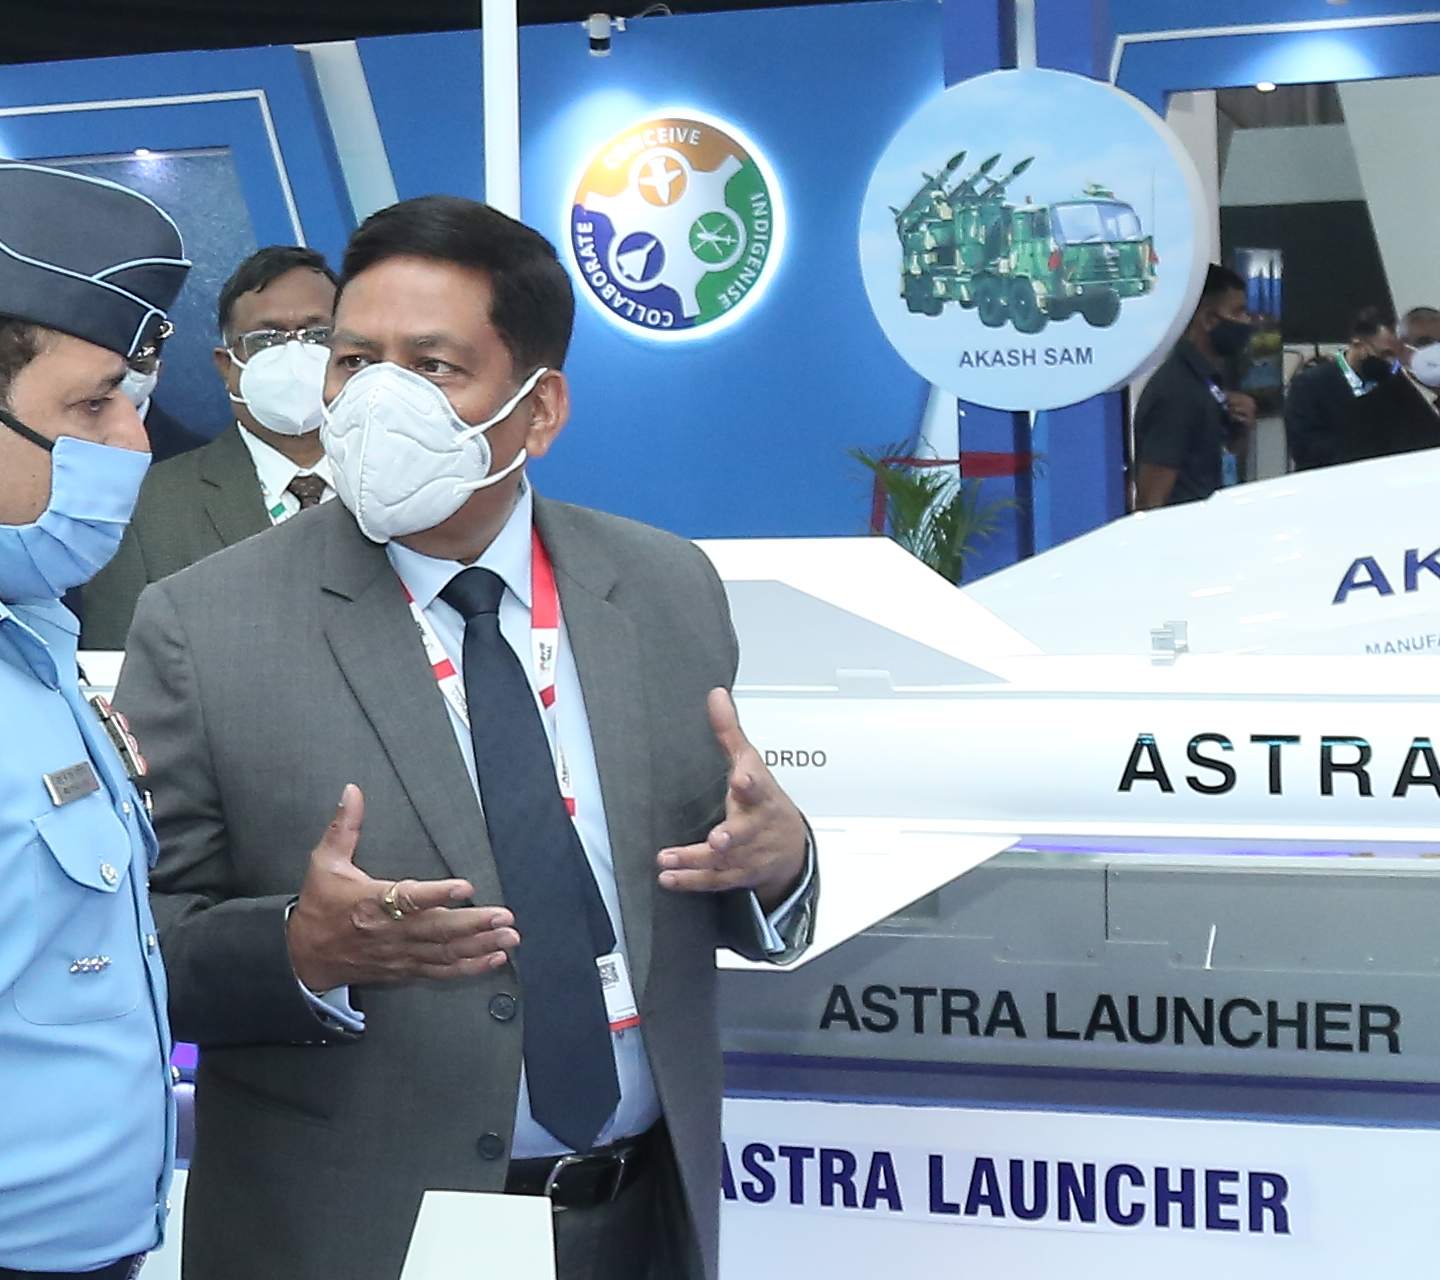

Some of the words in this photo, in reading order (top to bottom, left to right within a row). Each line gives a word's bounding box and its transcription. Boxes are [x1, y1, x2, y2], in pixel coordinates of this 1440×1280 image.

[602, 126, 702, 171] CONCEIVE
[575, 221, 675, 328] COLLABORATE
[717, 191, 770, 311] INDIGENISE
[958, 349, 1037, 369] AKASH
[1044, 347, 1094, 367] SAM
[765, 749, 828, 768] DRDO
[819, 984, 1027, 1040] ASTRA
[1045, 992, 1403, 1055] LAUNCHER
[927, 1153, 1291, 1235] LAUNCHER
